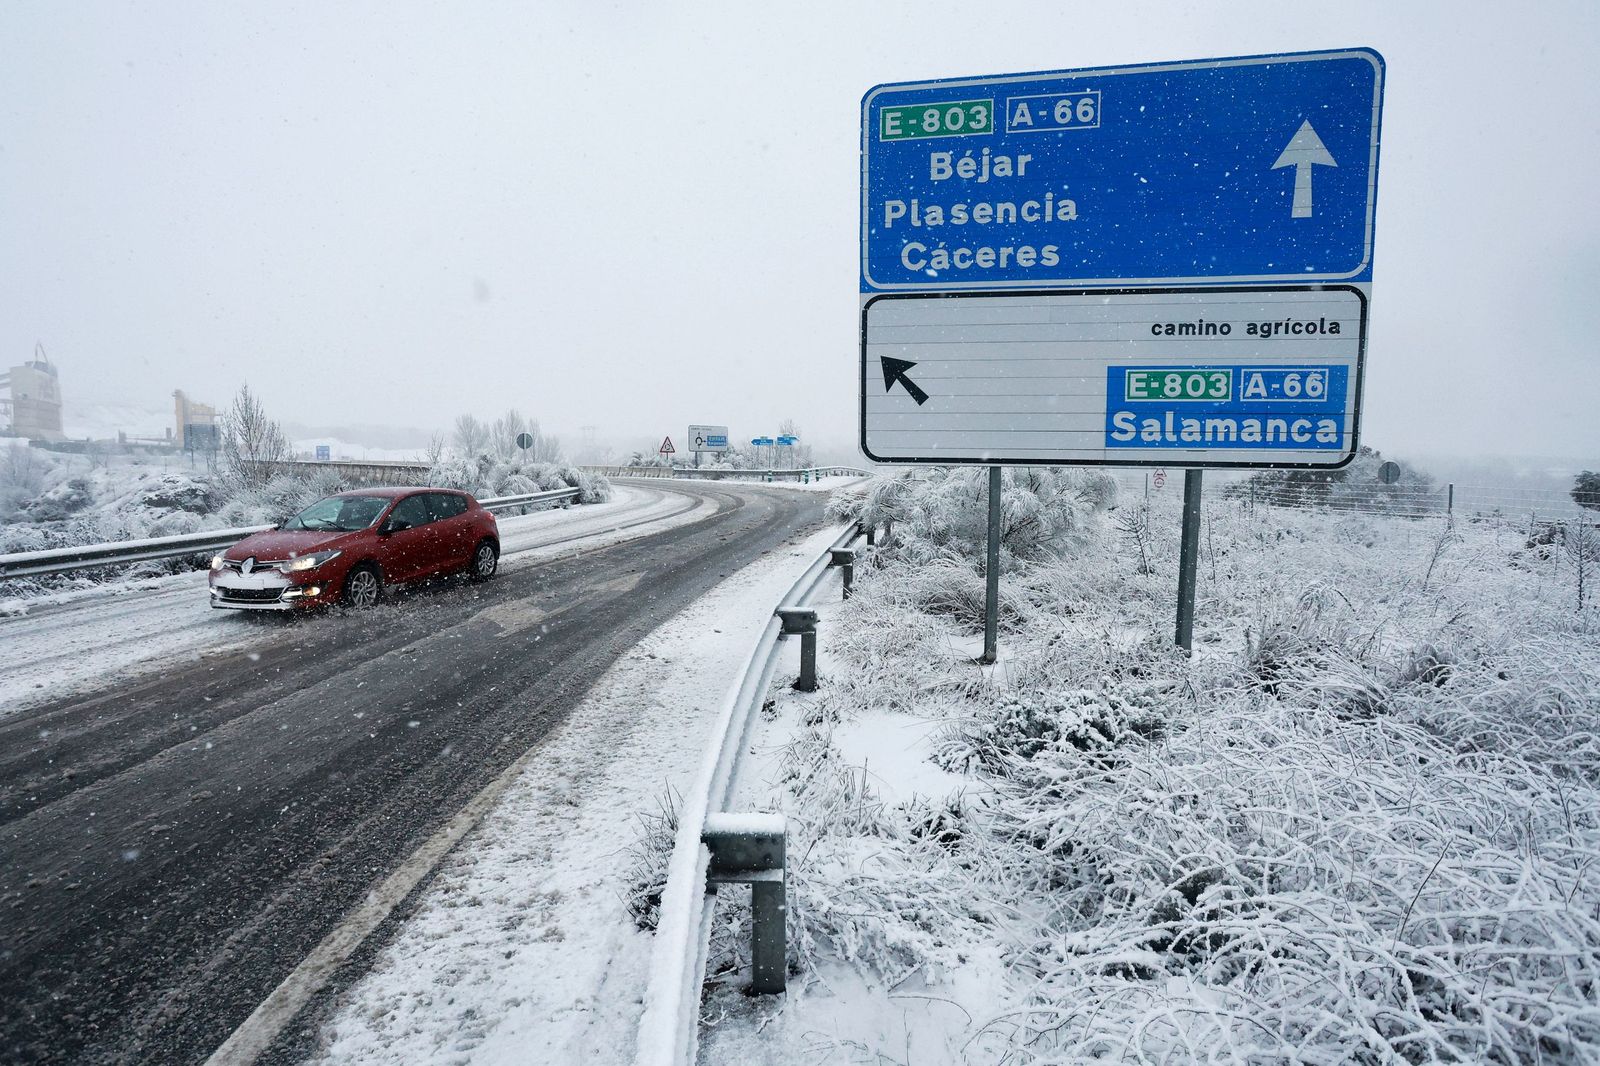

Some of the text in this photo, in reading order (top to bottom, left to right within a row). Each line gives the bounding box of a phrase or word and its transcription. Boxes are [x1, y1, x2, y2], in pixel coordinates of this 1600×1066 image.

[885, 98, 1095, 135] E-803 A-66
[930, 147, 1032, 183] Béjar
[885, 192, 1077, 228] Plasencia
[901, 242, 1060, 271] Cáceres
[1151, 317, 1341, 338] camino agrícola
[1129, 373, 1324, 398] E-803 A-66
[1110, 411, 1338, 443] Salamanca
